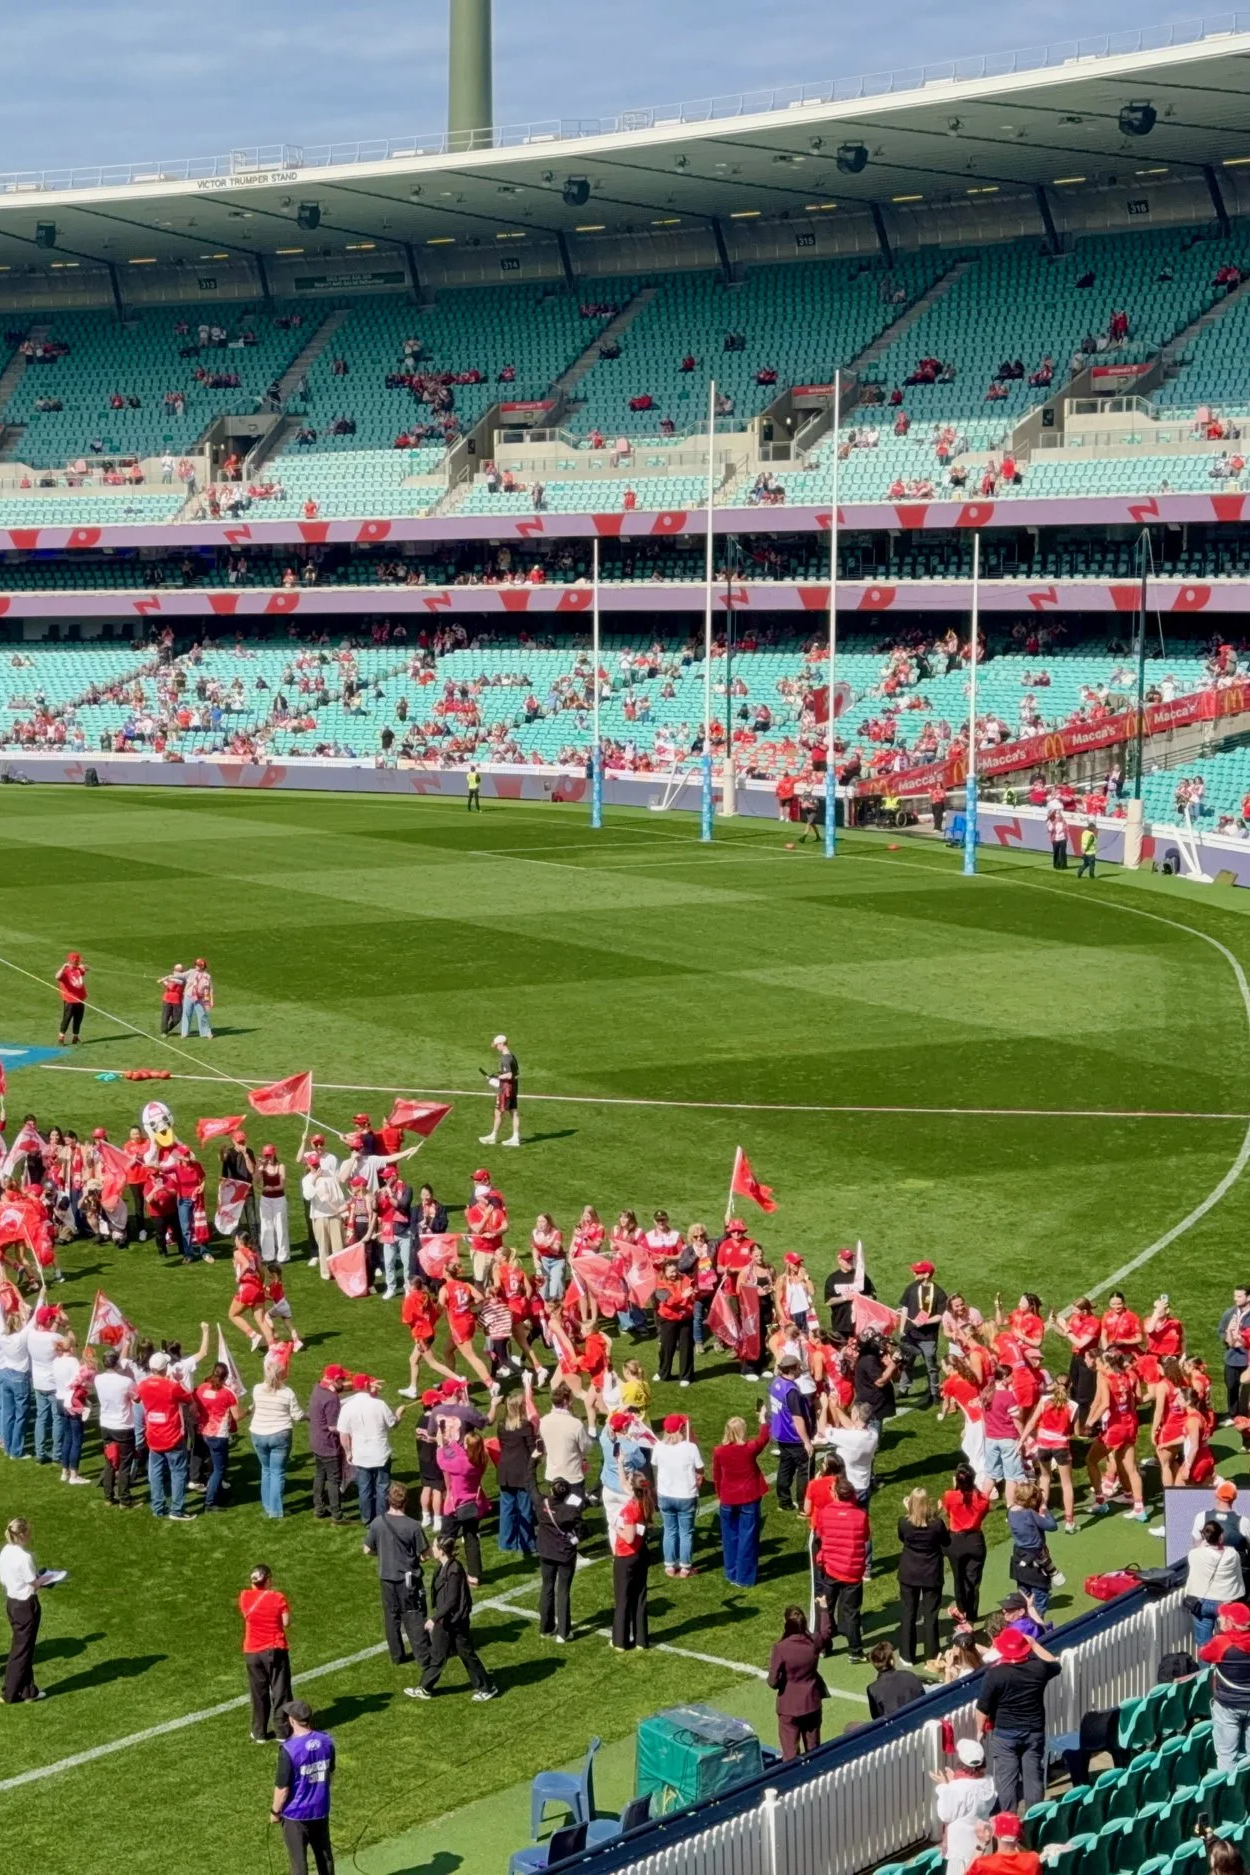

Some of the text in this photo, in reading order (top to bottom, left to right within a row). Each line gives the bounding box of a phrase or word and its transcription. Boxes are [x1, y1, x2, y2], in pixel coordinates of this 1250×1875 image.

[197, 172, 297, 189] VICTOR TRUMPER STAND
[1152, 703, 1196, 725] Macca's
[1072, 724, 1116, 746] Macca's
[982, 749, 1026, 769] Macca's
[898, 771, 943, 792] Macca's
